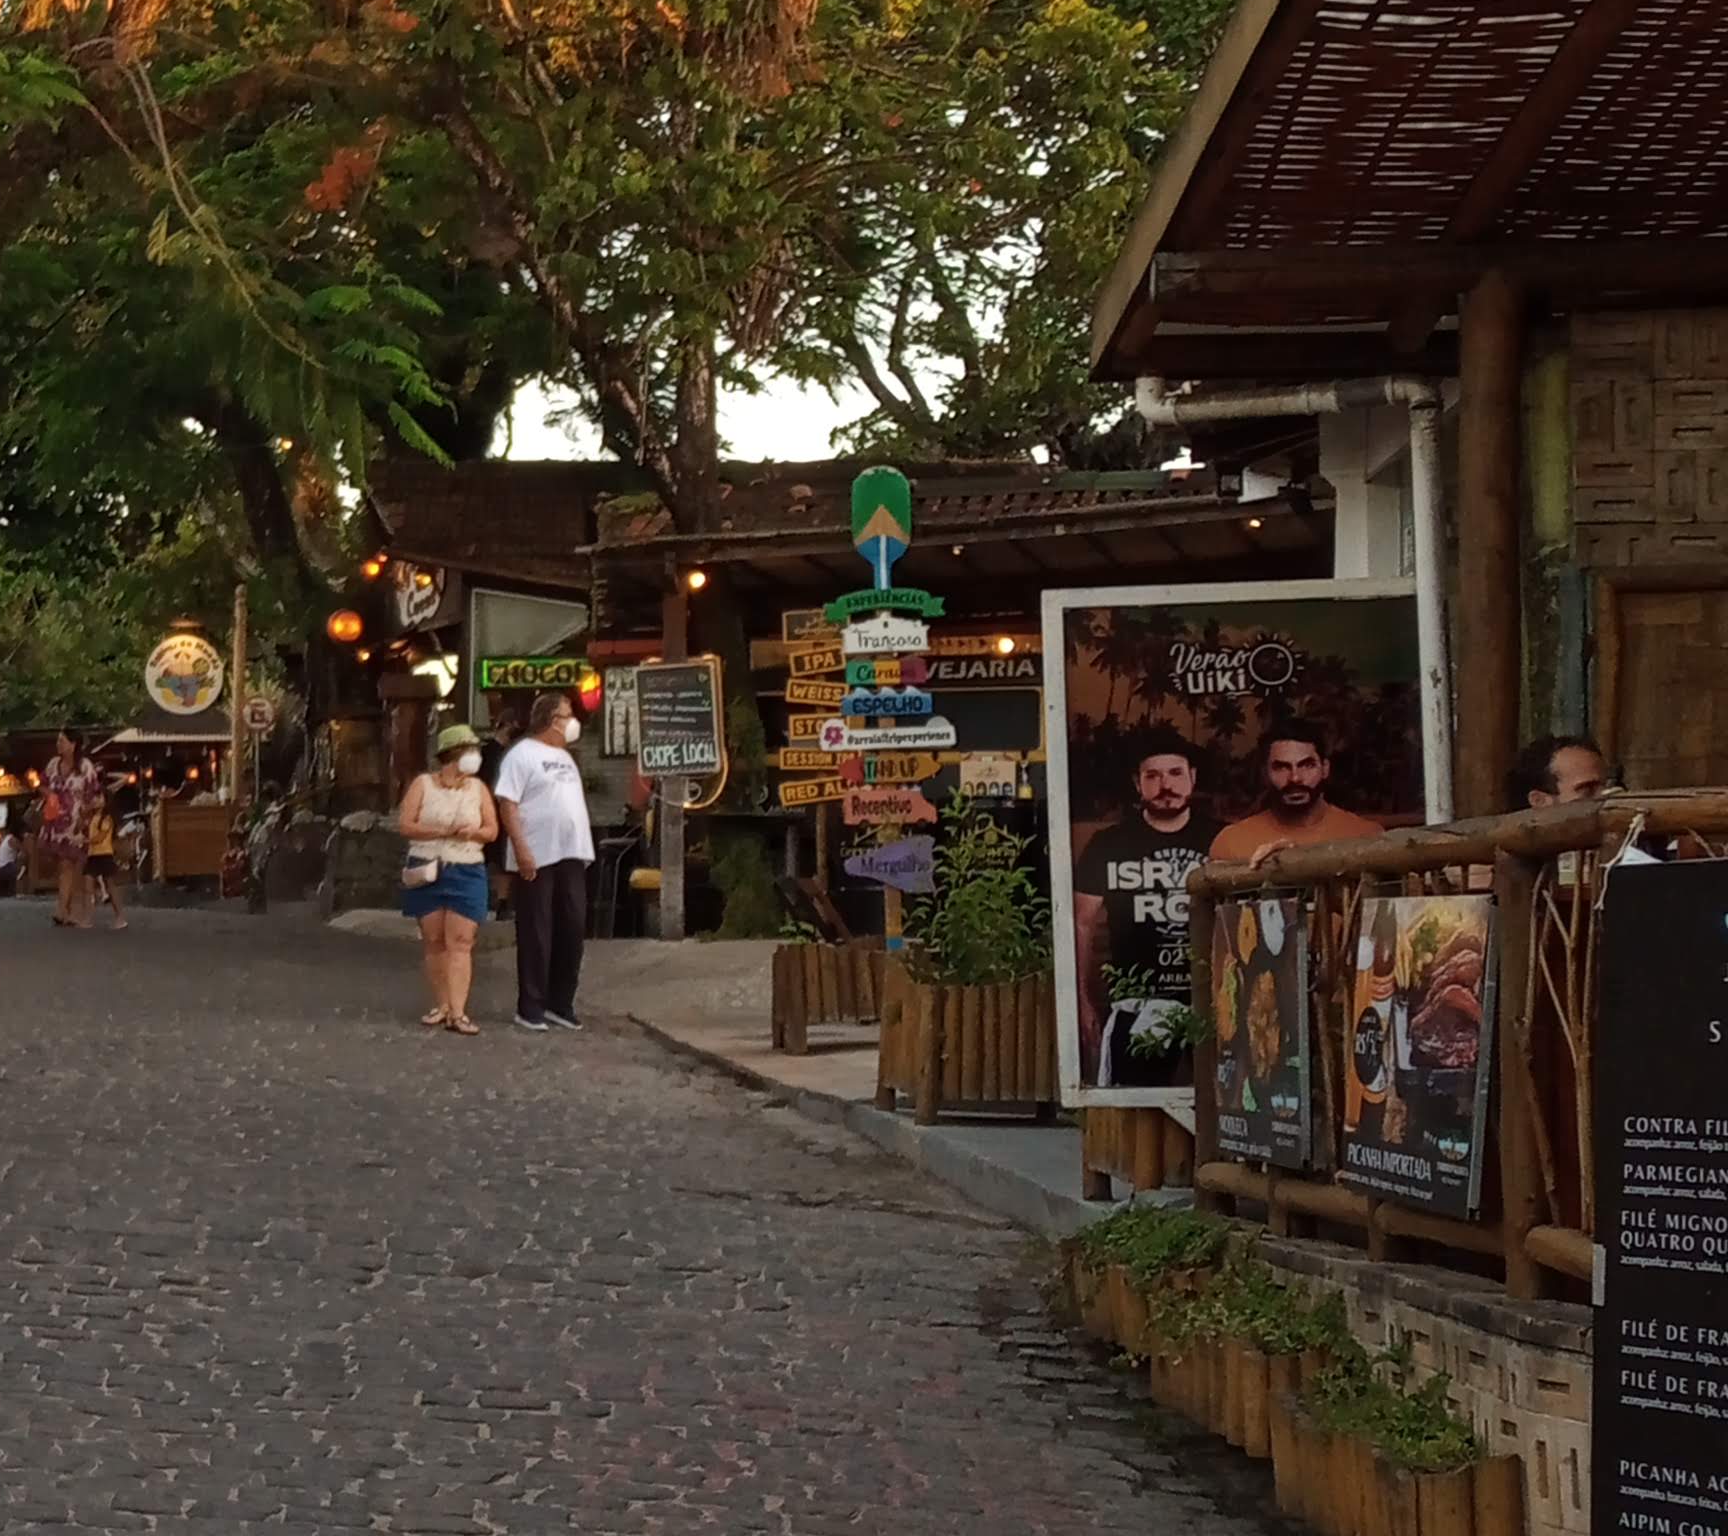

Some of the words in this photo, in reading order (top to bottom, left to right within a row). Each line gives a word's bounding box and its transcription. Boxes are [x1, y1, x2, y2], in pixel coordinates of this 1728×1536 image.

[803, 652, 836, 671] IPA
[1169, 641, 1251, 675] Verão
[792, 684, 843, 701] WEISS
[852, 696, 924, 714] ESPELHO
[643, 744, 681, 768] CHOPE
[683, 741, 718, 765] LOCAL
[786, 784, 819, 802] RED
[824, 781, 845, 796] AL
[1624, 1116, 1698, 1135] CONTRA
[1705, 1119, 1728, 1137] FIL
[1624, 1163, 1728, 1183] PARMEGIAN
[1621, 1208, 1657, 1228] FILÉ
[1665, 1213, 1728, 1234] MIGNO
[1620, 1230, 1695, 1252] QUATRO
[1621, 1318, 1658, 1340] FILÉ
[1665, 1324, 1689, 1343] DE
[1697, 1327, 1728, 1346] FRA
[1621, 1369, 1658, 1390] FILÉ
[1665, 1375, 1689, 1395] DE
[1697, 1379, 1728, 1399] FRA
[1619, 1459, 1700, 1489] PICANHA
[1618, 1512, 1671, 1535] AIPIM
